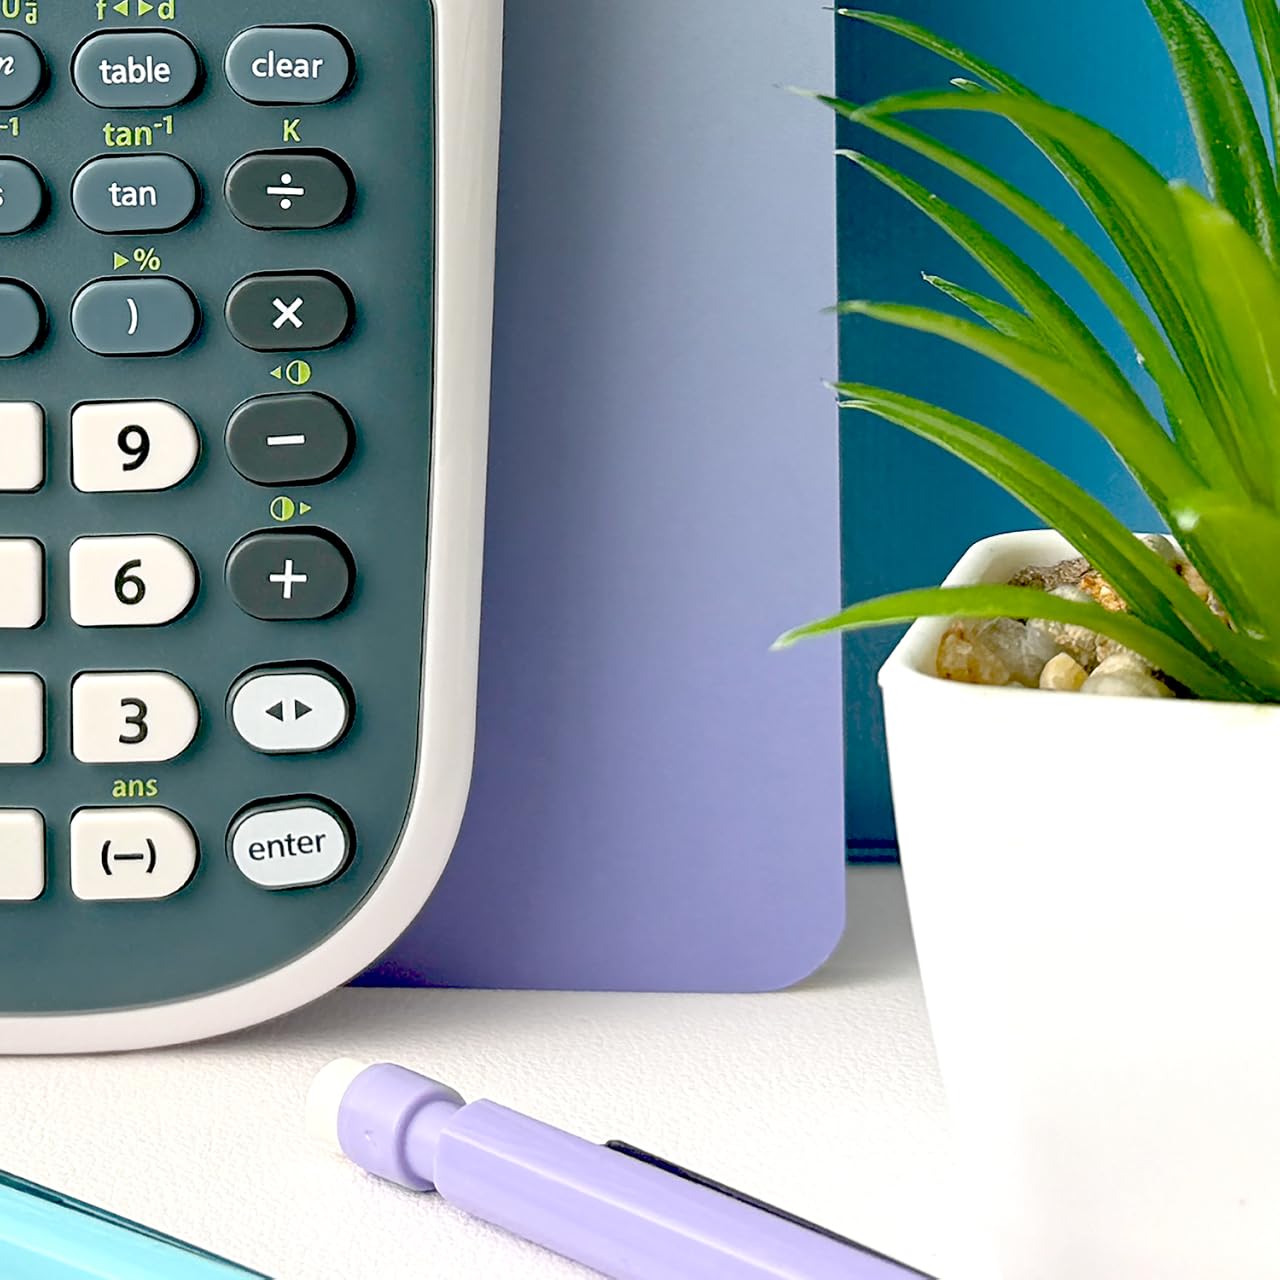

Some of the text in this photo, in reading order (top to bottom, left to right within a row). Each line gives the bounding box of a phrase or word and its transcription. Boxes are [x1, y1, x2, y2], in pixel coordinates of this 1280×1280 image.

[98, 55, 171, 84] table
[251, 50, 323, 78] clear
[283, 119, 300, 142] K
[108, 182, 157, 207] tan
[117, 424, 150, 472] 9
[114, 559, 146, 605] 6
[118, 698, 148, 745] 3
[112, 779, 158, 798] ans
[248, 833, 326, 861] enter
